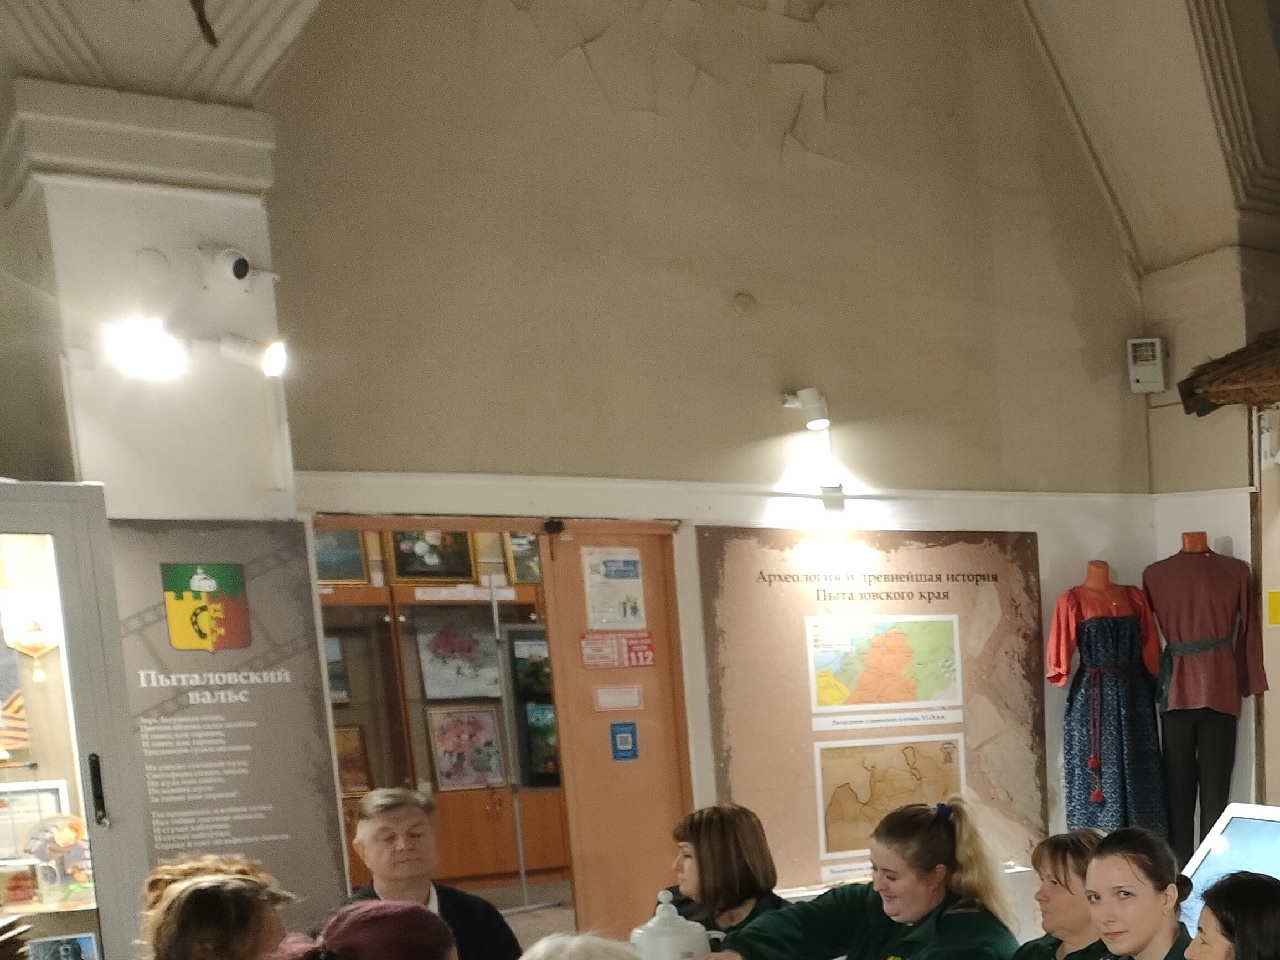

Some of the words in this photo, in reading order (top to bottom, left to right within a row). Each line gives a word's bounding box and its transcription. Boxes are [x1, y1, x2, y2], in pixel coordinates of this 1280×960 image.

[946, 574, 998, 586] история
[918, 591, 950, 603] края
[629, 650, 655, 666] 112
[137, 667, 292, 688] Пыталовский
[188, 690, 249, 704] вальс
